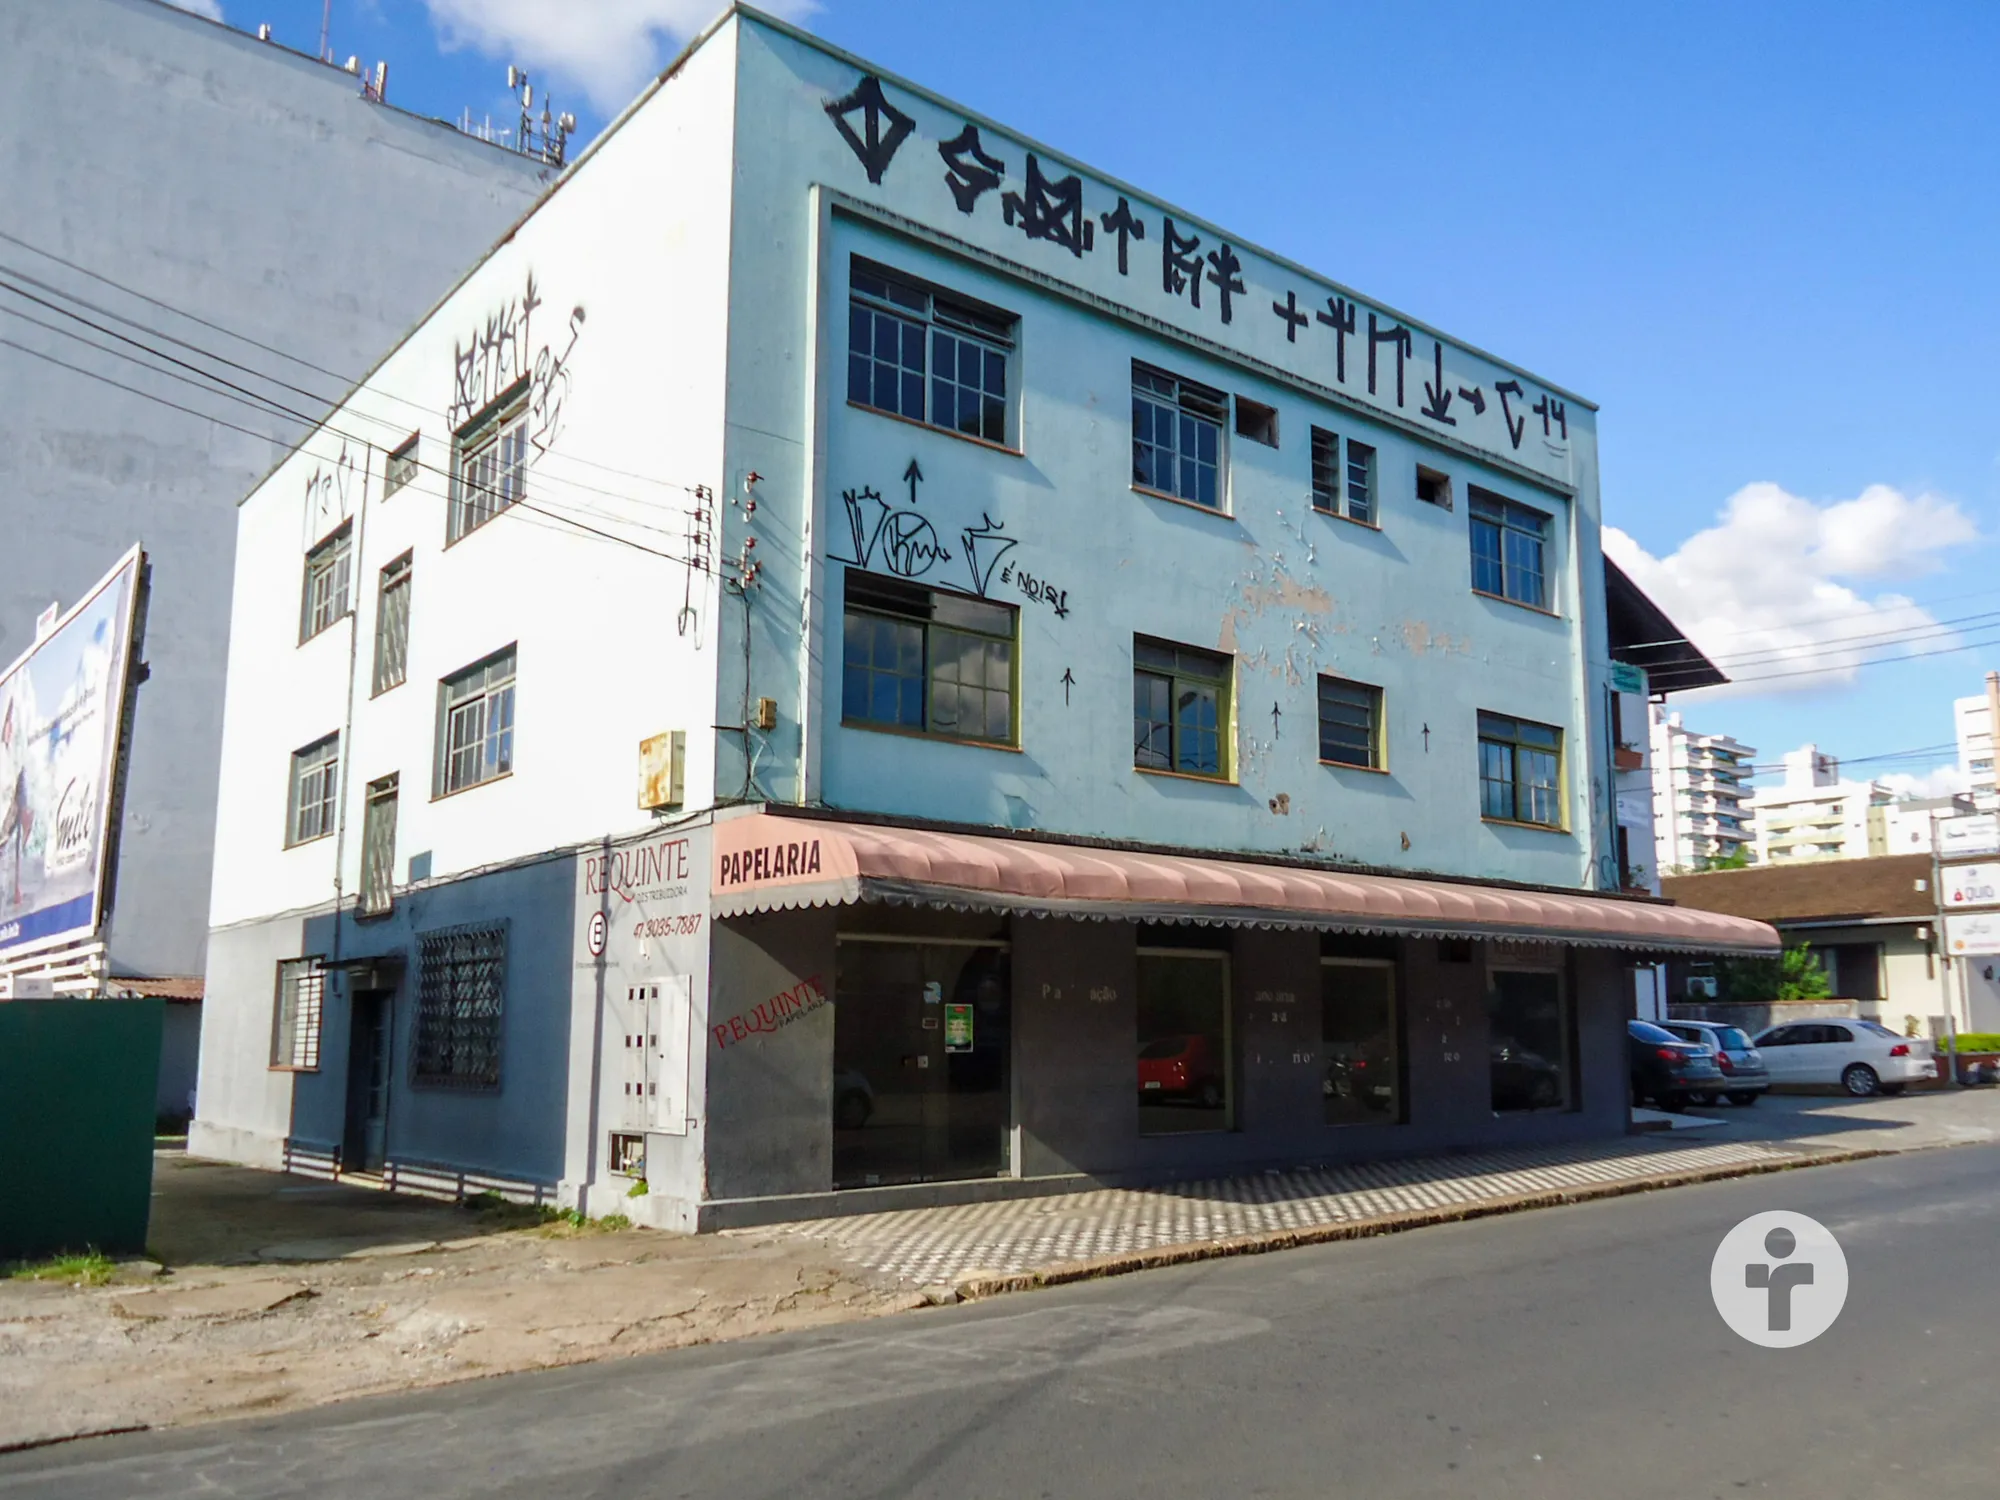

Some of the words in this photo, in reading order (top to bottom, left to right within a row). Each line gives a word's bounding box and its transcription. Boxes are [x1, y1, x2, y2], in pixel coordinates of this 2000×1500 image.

[585, 838, 690, 903] REQUINTE
[720, 839, 821, 886] PAPELARIA
[594, 921, 602, 946] E
